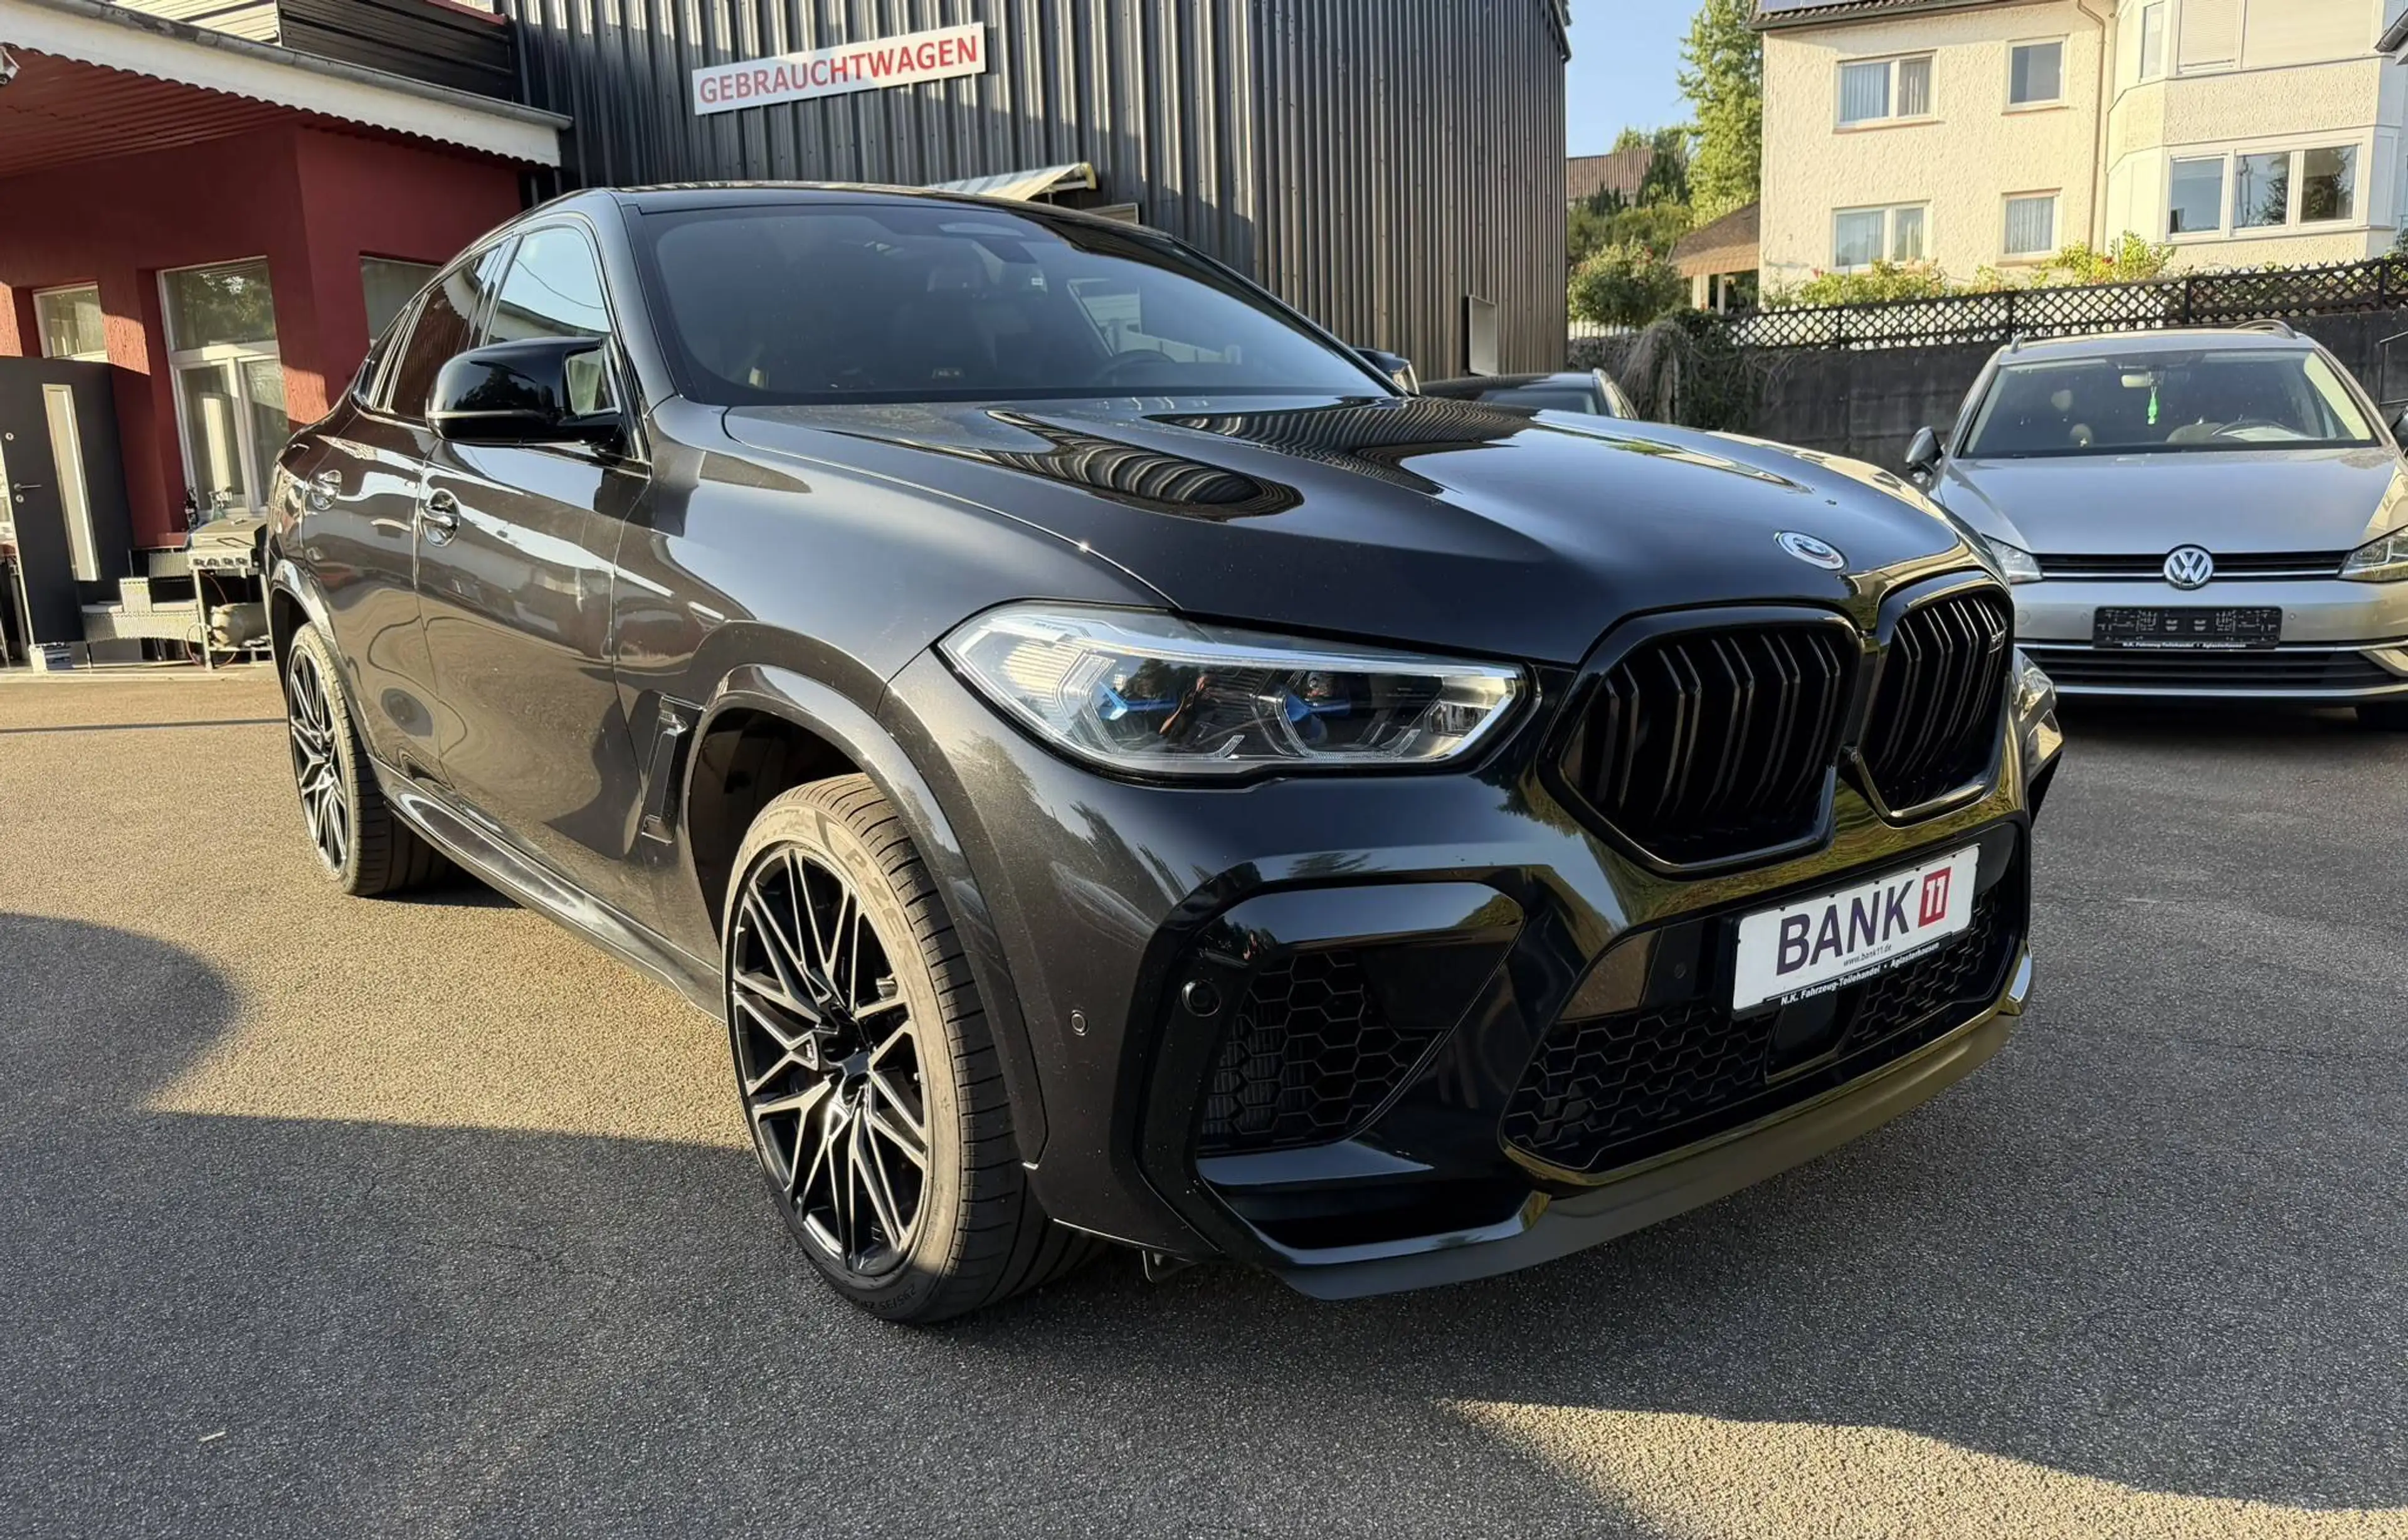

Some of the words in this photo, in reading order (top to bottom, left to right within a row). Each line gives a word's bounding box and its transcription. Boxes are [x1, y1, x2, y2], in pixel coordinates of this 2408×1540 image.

[699, 35, 977, 104] GEBRAUCHTWAGEN
[1777, 879, 1916, 976] BANK
[1923, 873, 1948, 920] 11
[1844, 942, 1892, 967] www.bank11.de
[1781, 992, 1799, 1006] N.K.
[1801, 964, 1881, 999] Fahrzeug-Teilehandel
